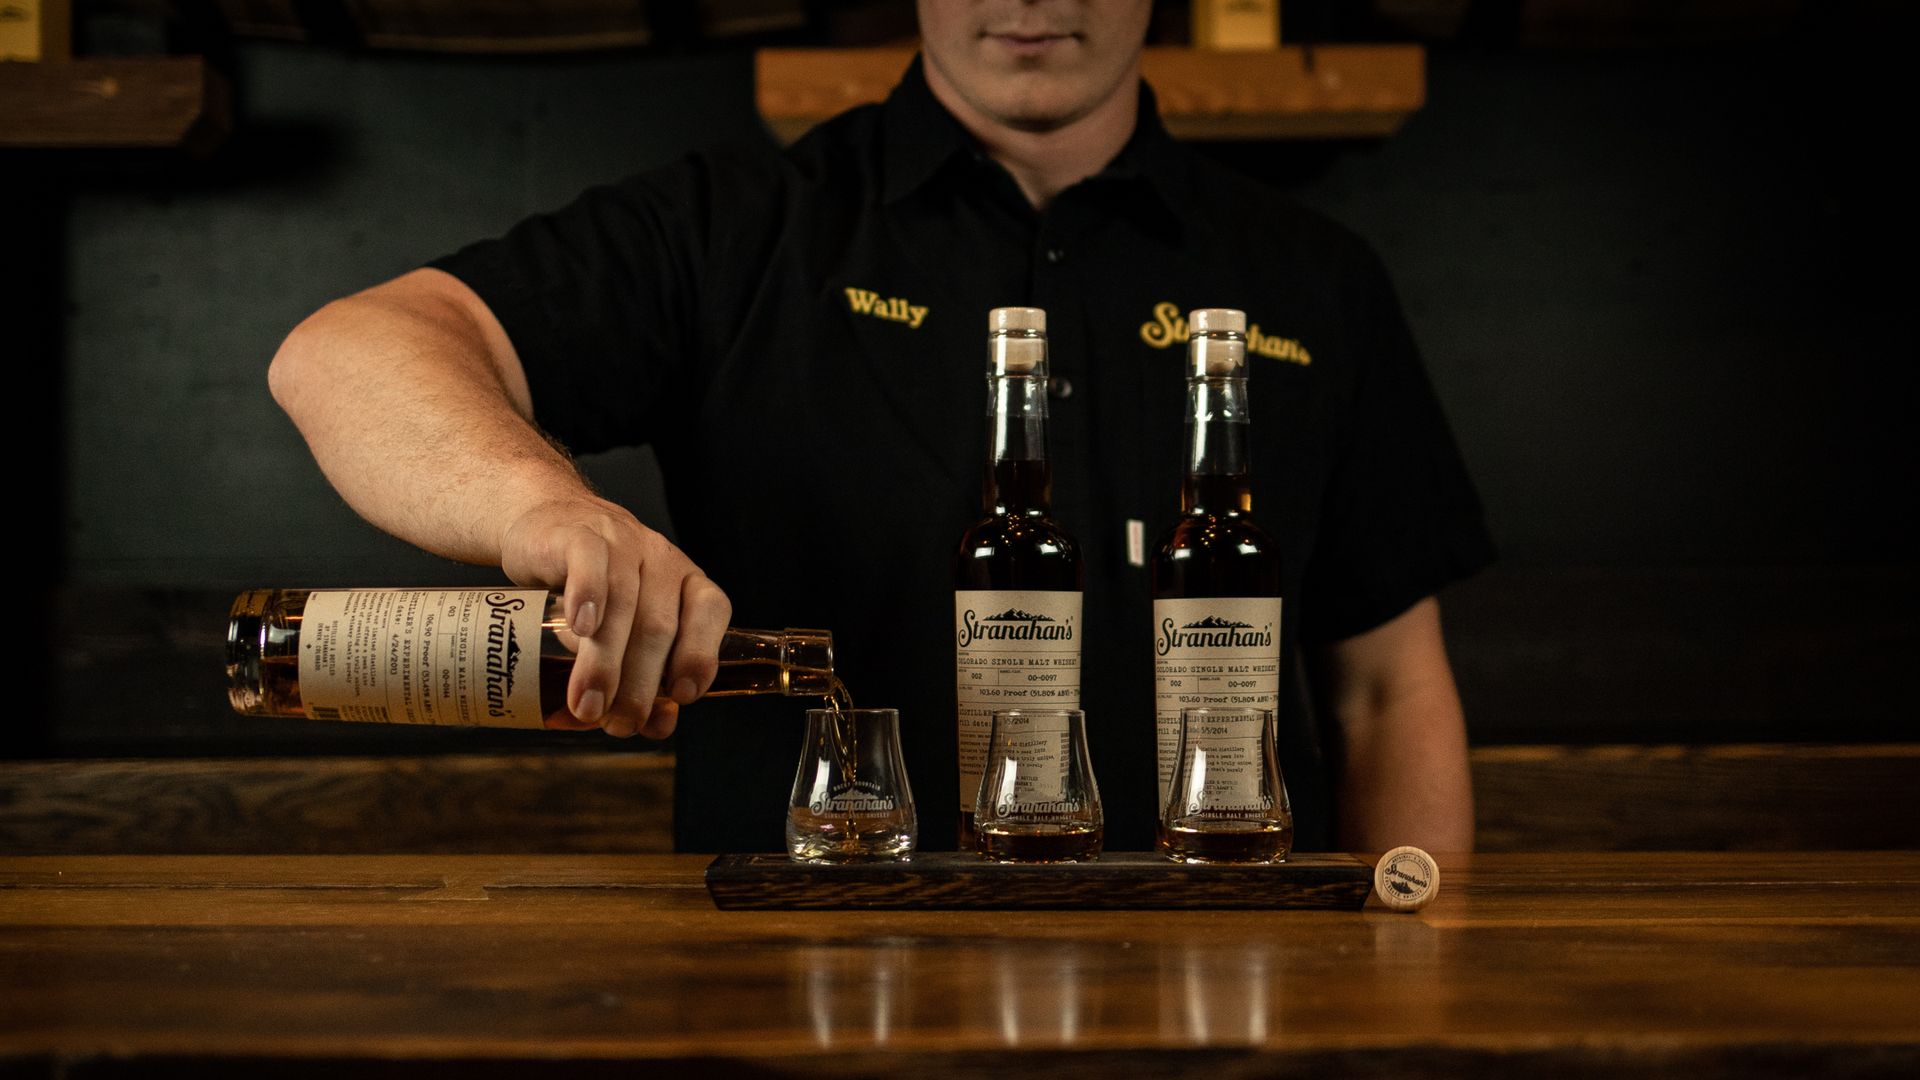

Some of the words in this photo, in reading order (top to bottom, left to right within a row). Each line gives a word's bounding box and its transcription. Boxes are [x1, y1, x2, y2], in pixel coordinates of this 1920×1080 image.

[845, 287, 929, 330] Wally
[394, 605, 404, 625] date:
[448, 606, 457, 617] 003
[424, 614, 434, 636] 106.90
[958, 609, 1072, 648] Stranahan's
[370, 627, 379, 651] limited
[458, 627, 468, 662] SINGLE
[1157, 618, 1271, 656] Stranahan's
[353, 656, 361, 674] truly
[390, 634, 400, 675] 4/24/2013
[422, 640, 431, 668] Proof
[485, 592, 525, 718] Stranahan's
[991, 659, 1024, 667] SINGLE
[1028, 659, 1050, 667] MALT
[345, 662, 353, 683] purely
[369, 653, 377, 687] distillery
[402, 640, 412, 705] EXPERIMENTAL
[458, 667, 467, 690] MALT
[1027, 674, 1057, 683] 00-0097
[1228, 665, 1249, 673] MALT
[1003, 689, 1027, 697] Proof
[1228, 681, 1257, 689] 00-0097
[1207, 715, 1254, 723] EXPERIMENTAL
[1201, 727, 1228, 735] 5/5/2014
[811, 791, 893, 816] Stranahan's
[996, 793, 1080, 817] Stranahan's
[1384, 863, 1428, 888] Stranahan's
